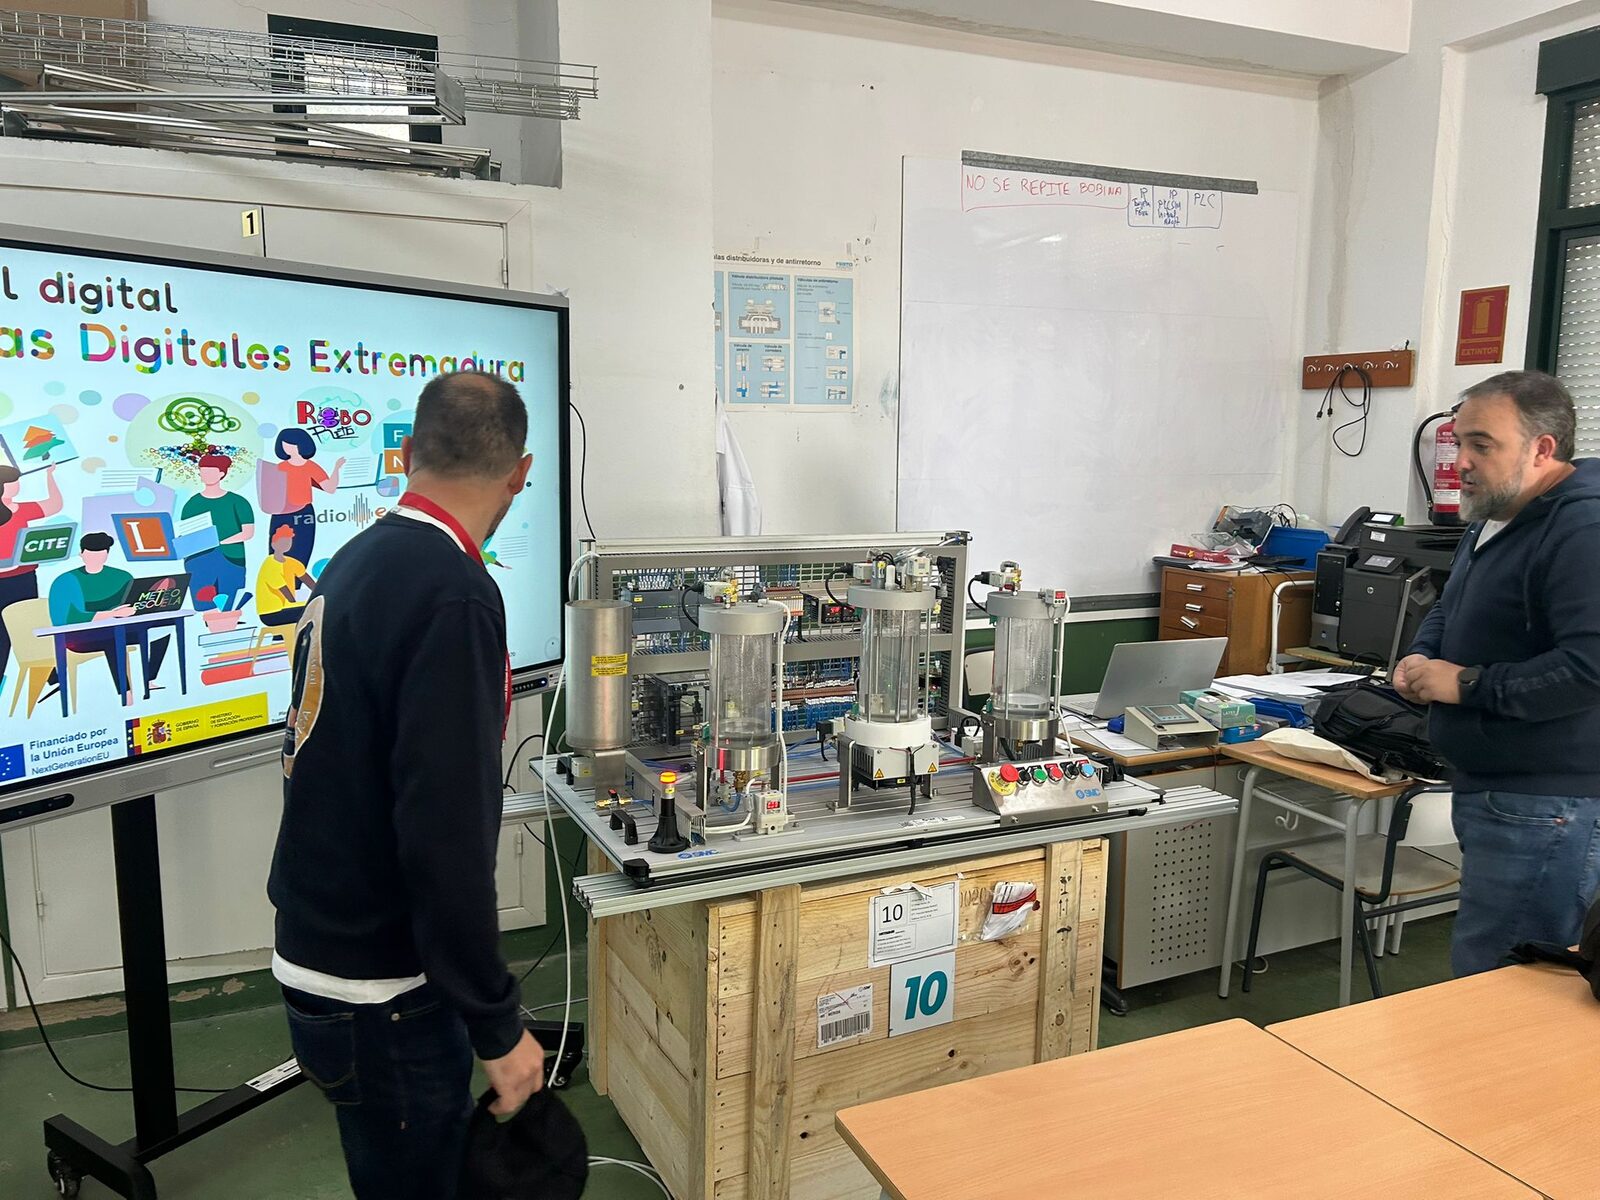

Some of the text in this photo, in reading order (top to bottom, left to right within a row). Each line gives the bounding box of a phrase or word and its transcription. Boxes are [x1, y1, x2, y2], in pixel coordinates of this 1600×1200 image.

[966, 174, 1122, 197] NO SE REPITE BOBINA
[1193, 192, 1215, 208] PLC
[246, 212, 254, 234] 1
[726, 254, 769, 263] distribuidoras
[785, 258, 821, 266] antirretorno
[39, 271, 178, 315] digital
[80, 323, 292, 374] Digitales
[309, 338, 525, 383] Extremadura
[1460, 346, 1499, 356] EXTINTOR
[293, 509, 346, 525] radio
[24, 536, 69, 553] CITE
[126, 521, 165, 552] L
[133, 596, 181, 611] ESCUELA
[139, 588, 181, 602] METEO
[175, 719, 199, 727] GOBIERNO
[29, 728, 107, 750] Financiado por
[30, 737, 119, 762] la Unión Europea
[31, 751, 109, 775] NextGenerationEU
[882, 903, 903, 924] 10
[905, 970, 948, 1020] 10
